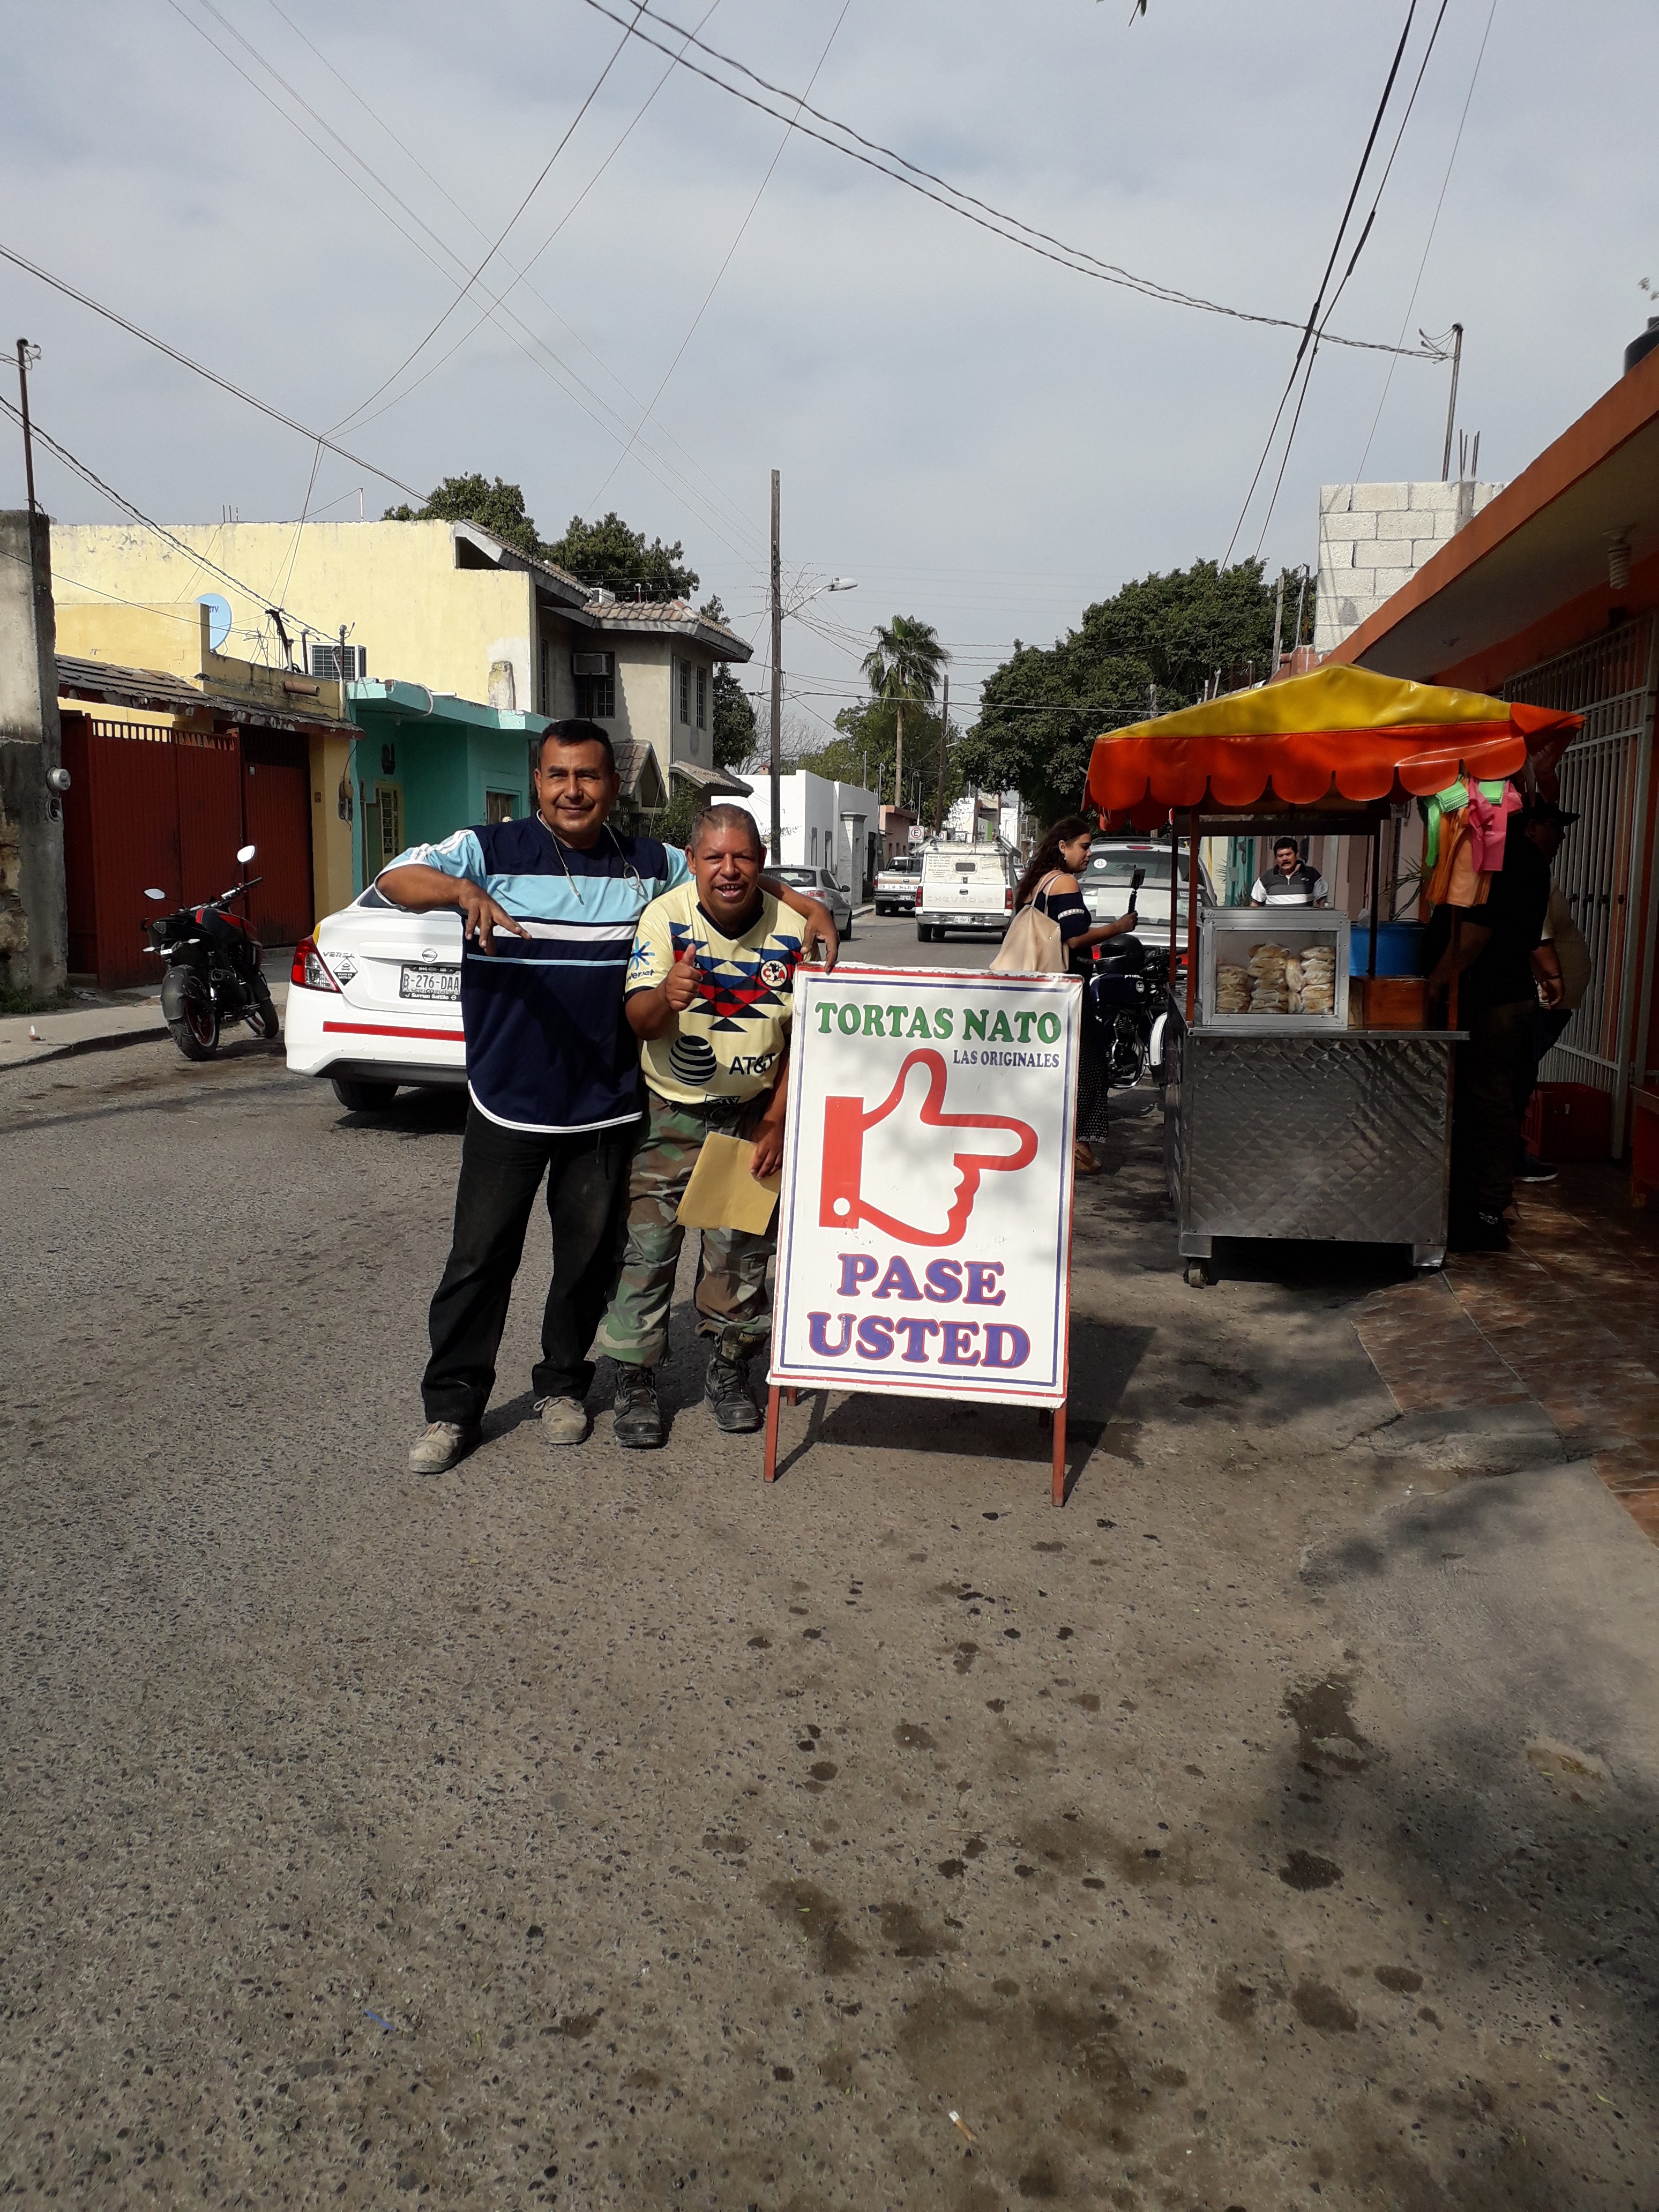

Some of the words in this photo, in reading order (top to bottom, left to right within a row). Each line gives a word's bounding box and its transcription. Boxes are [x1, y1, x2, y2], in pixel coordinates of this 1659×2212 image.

[403, 973, 459, 990] B-276-DAA
[815, 1002, 953, 1040] TORTAS
[963, 1009, 1062, 1044] NATO
[728, 1052, 776, 1075] AT&T
[953, 1049, 978, 1065] LAS
[980, 1050, 1059, 1068] ORIGINALES
[836, 1253, 1006, 1307] PASE
[807, 1311, 1031, 1369] USTED
